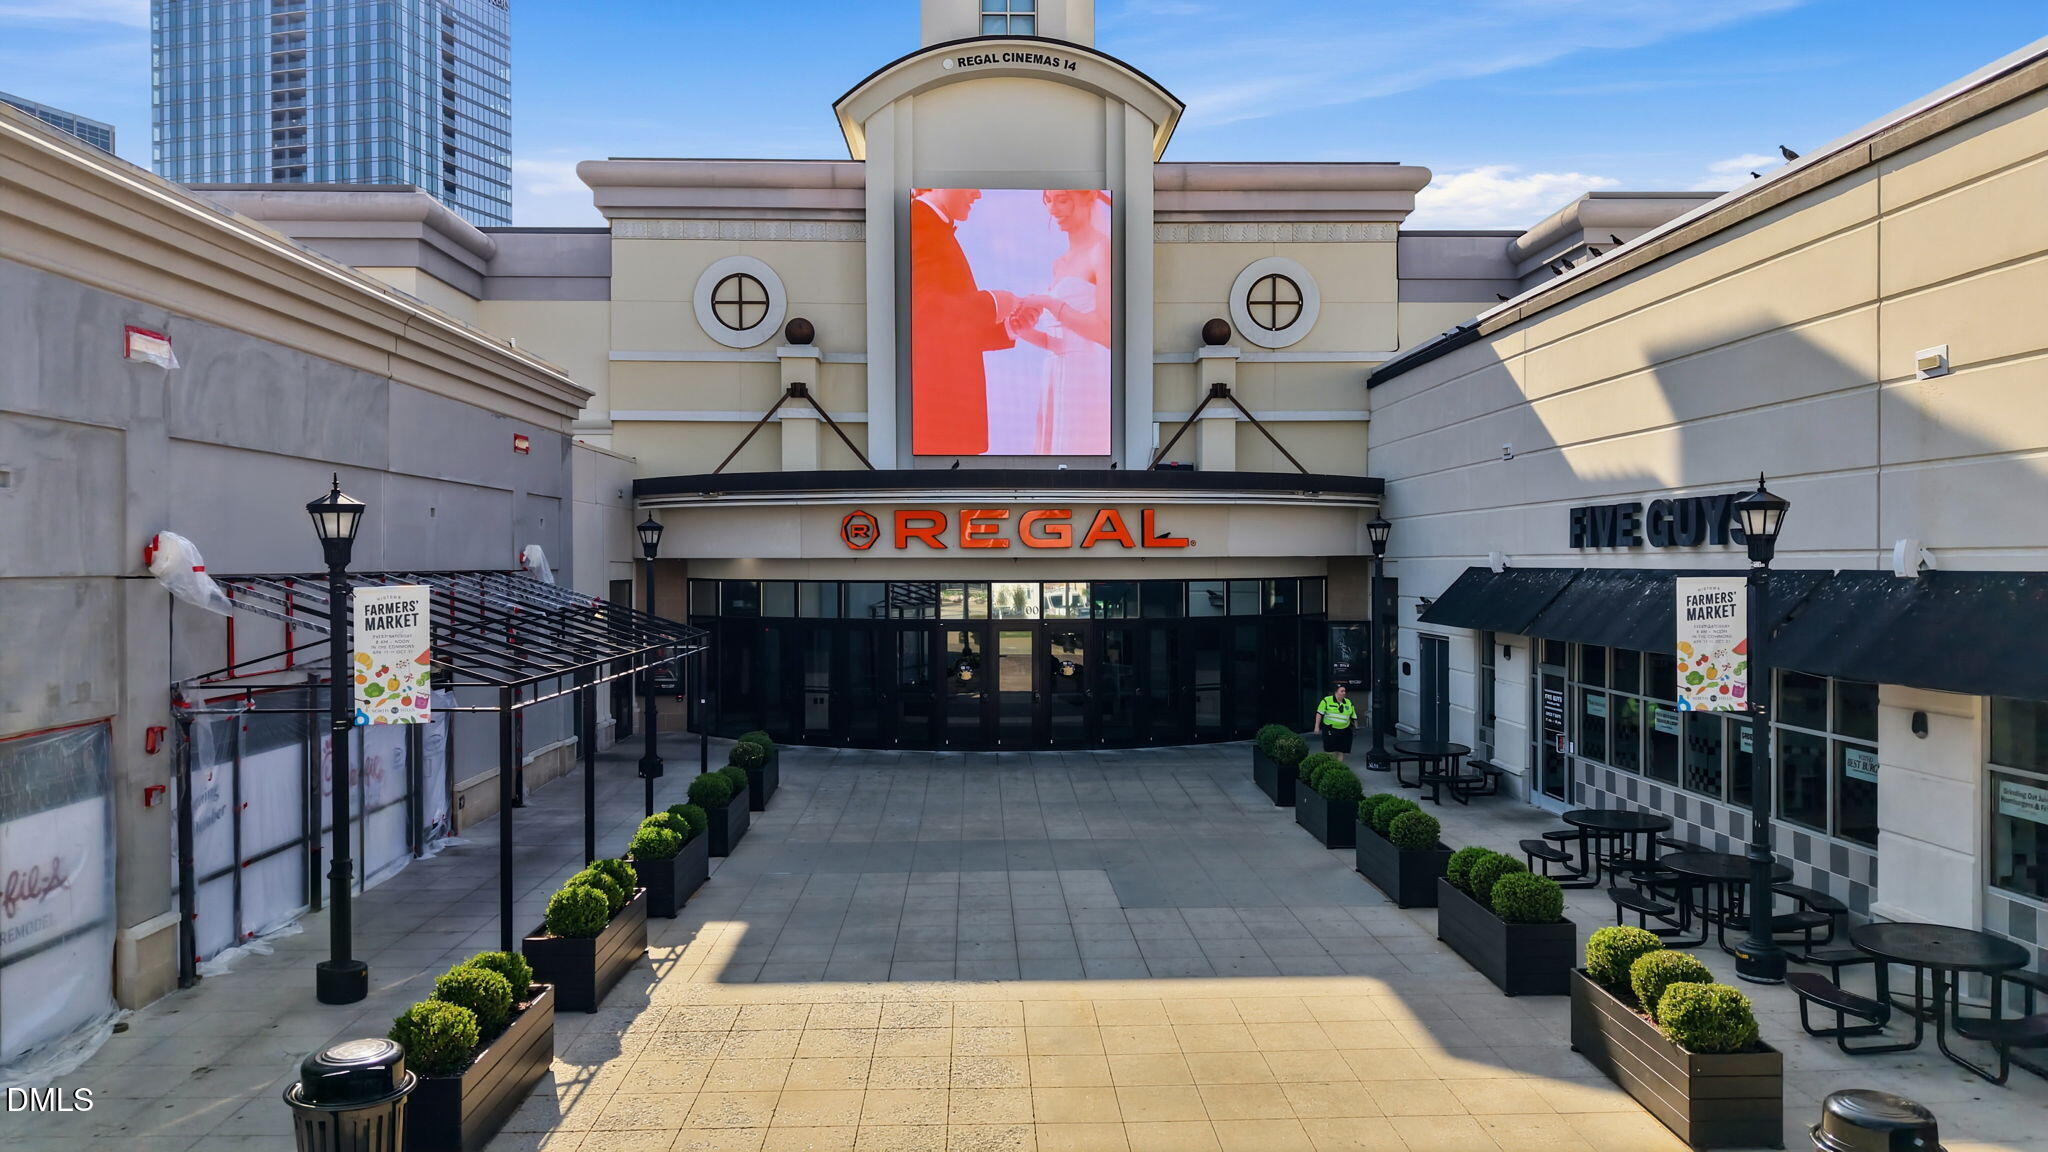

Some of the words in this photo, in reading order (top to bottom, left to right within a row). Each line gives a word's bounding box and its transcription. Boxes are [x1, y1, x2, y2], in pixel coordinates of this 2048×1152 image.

[957, 53, 999, 68] REGAL
[1002, 52, 1060, 67] CINEMAS
[1064, 60, 1076, 71] 14
[894, 509, 1190, 549] REGAL
[1569, 503, 1643, 549] FIVE
[1686, 604, 1737, 621] MARKET
[364, 613, 419, 632] MARKET
[1847, 758, 1862, 769] BEST
